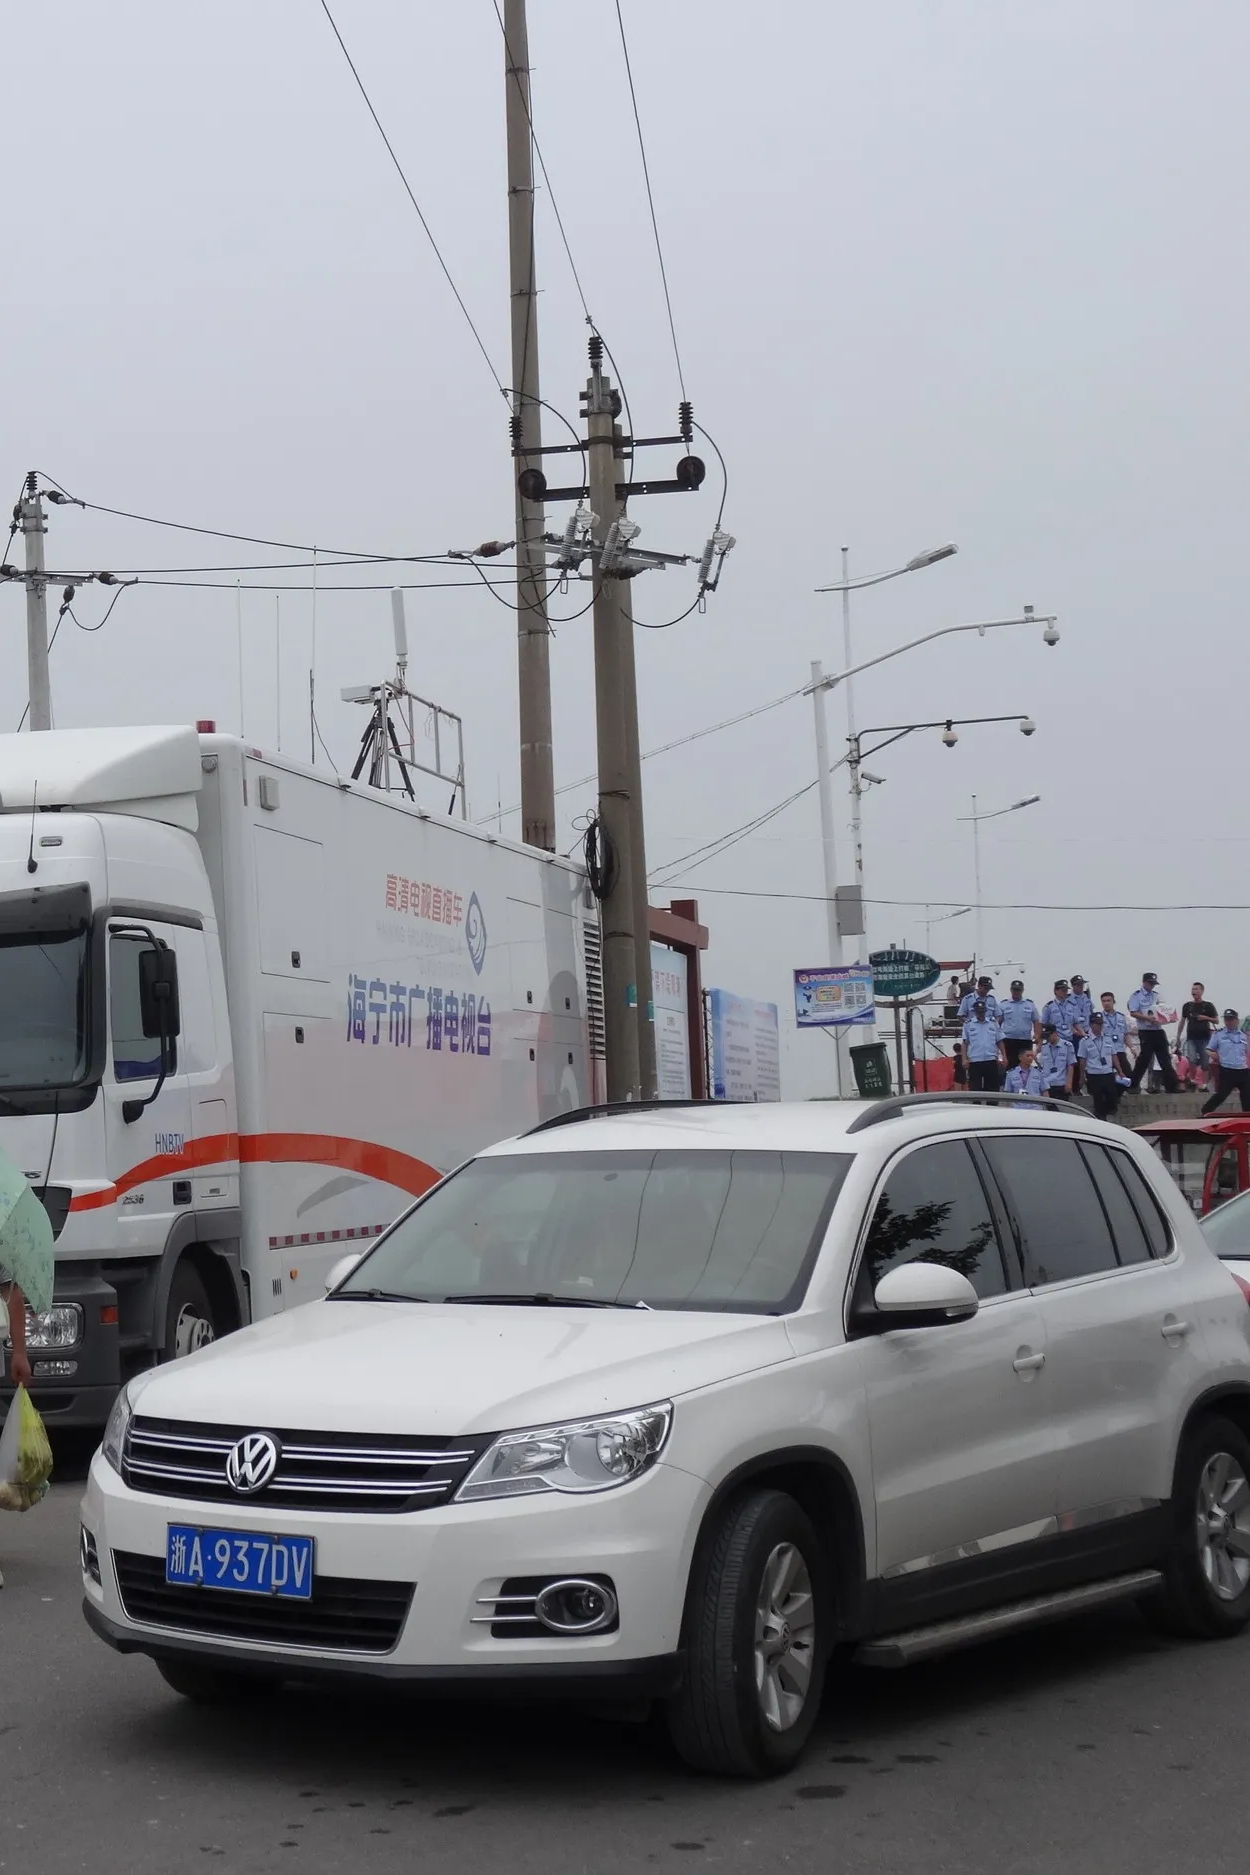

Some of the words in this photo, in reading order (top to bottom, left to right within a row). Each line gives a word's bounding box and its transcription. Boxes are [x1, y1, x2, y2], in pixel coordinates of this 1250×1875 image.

[386, 873, 463, 927] 高清电视直播车
[346, 972, 492, 1056] 海宁市广播电视台
[154, 1133, 184, 1154] HNBTV
